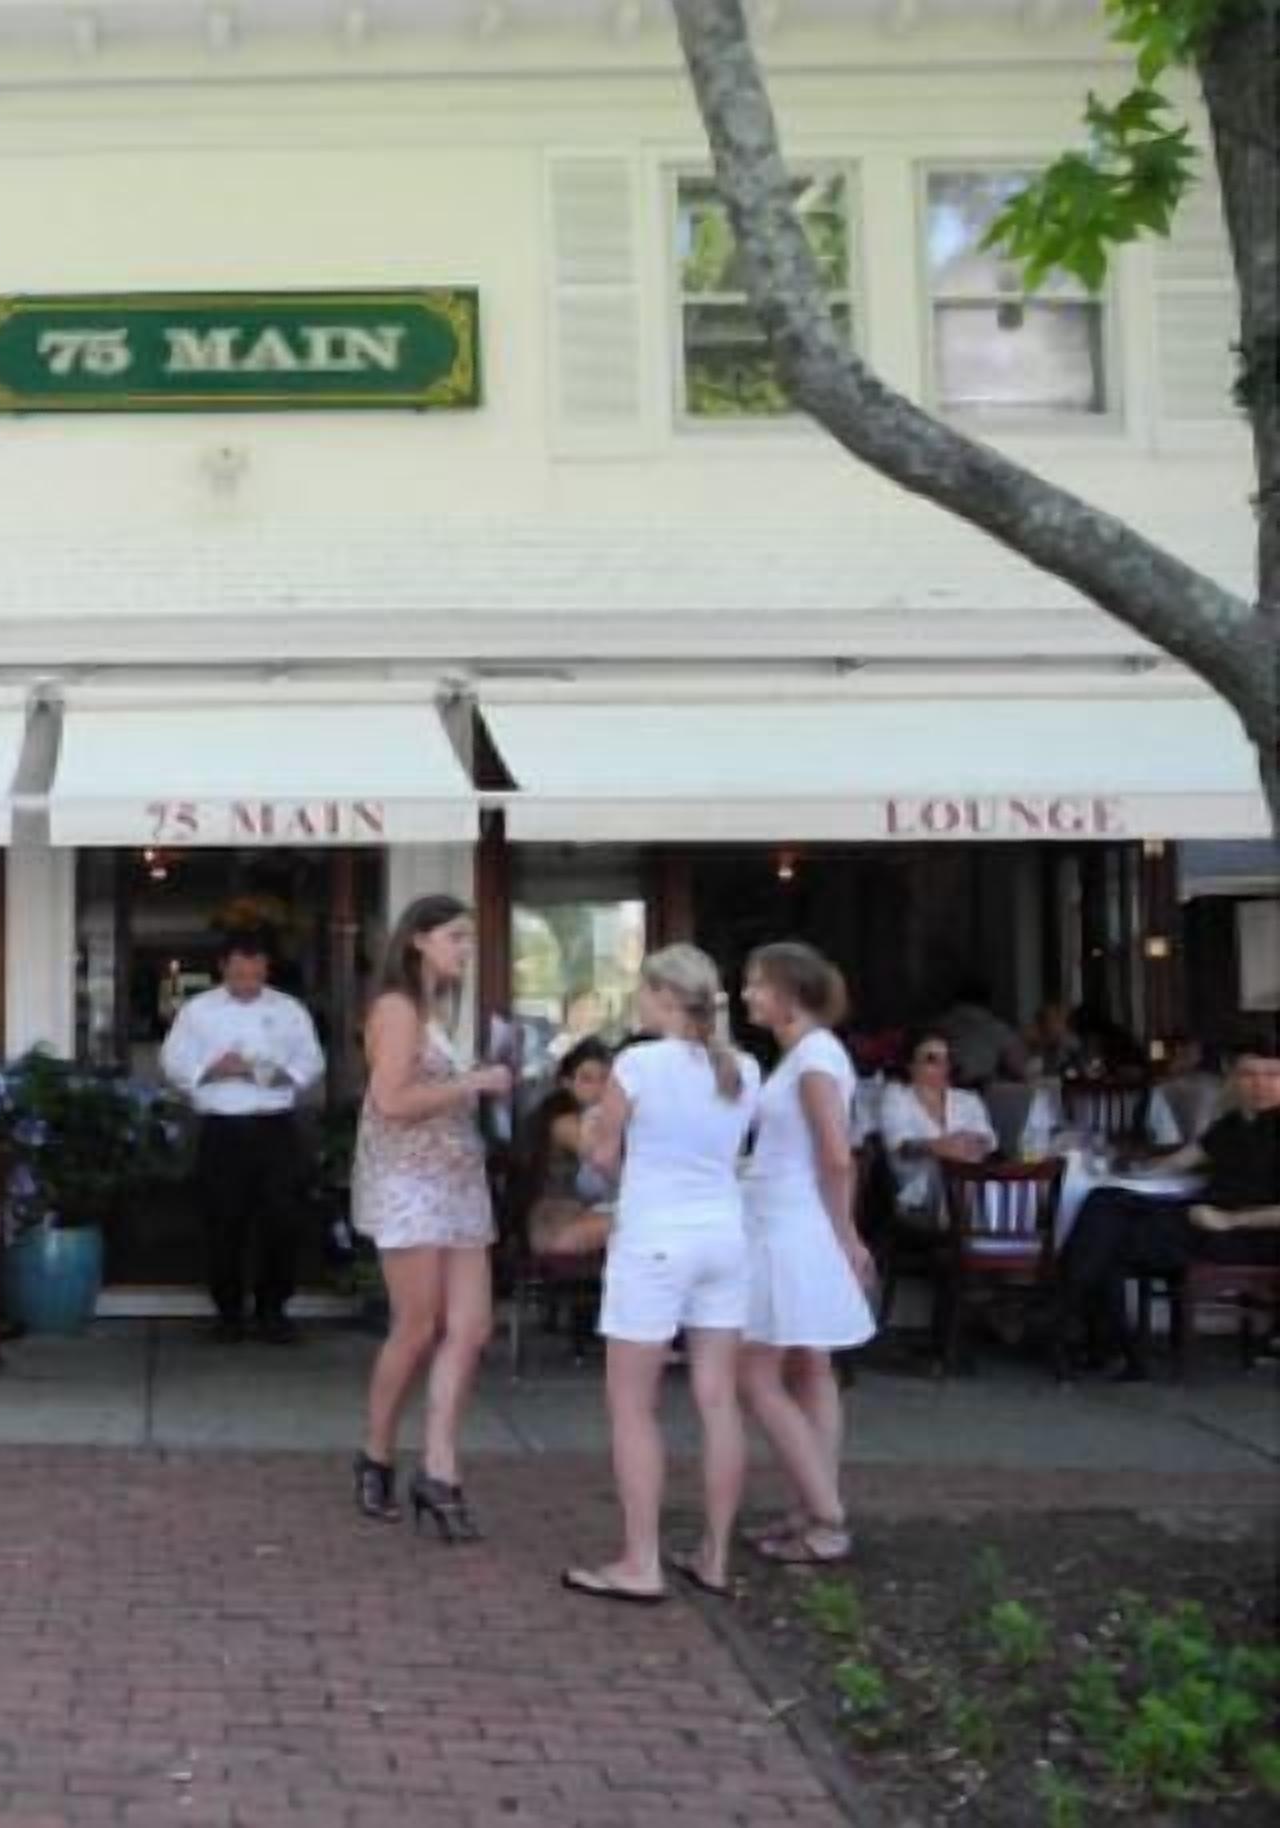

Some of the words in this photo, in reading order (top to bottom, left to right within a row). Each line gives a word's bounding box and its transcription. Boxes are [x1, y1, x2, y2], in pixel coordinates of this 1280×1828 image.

[37, 328, 131, 374] 75
[164, 326, 405, 372] MAIN
[146, 800, 199, 841] 75
[231, 800, 386, 835] MAIN
[885, 798, 1126, 834] LOUNGE
